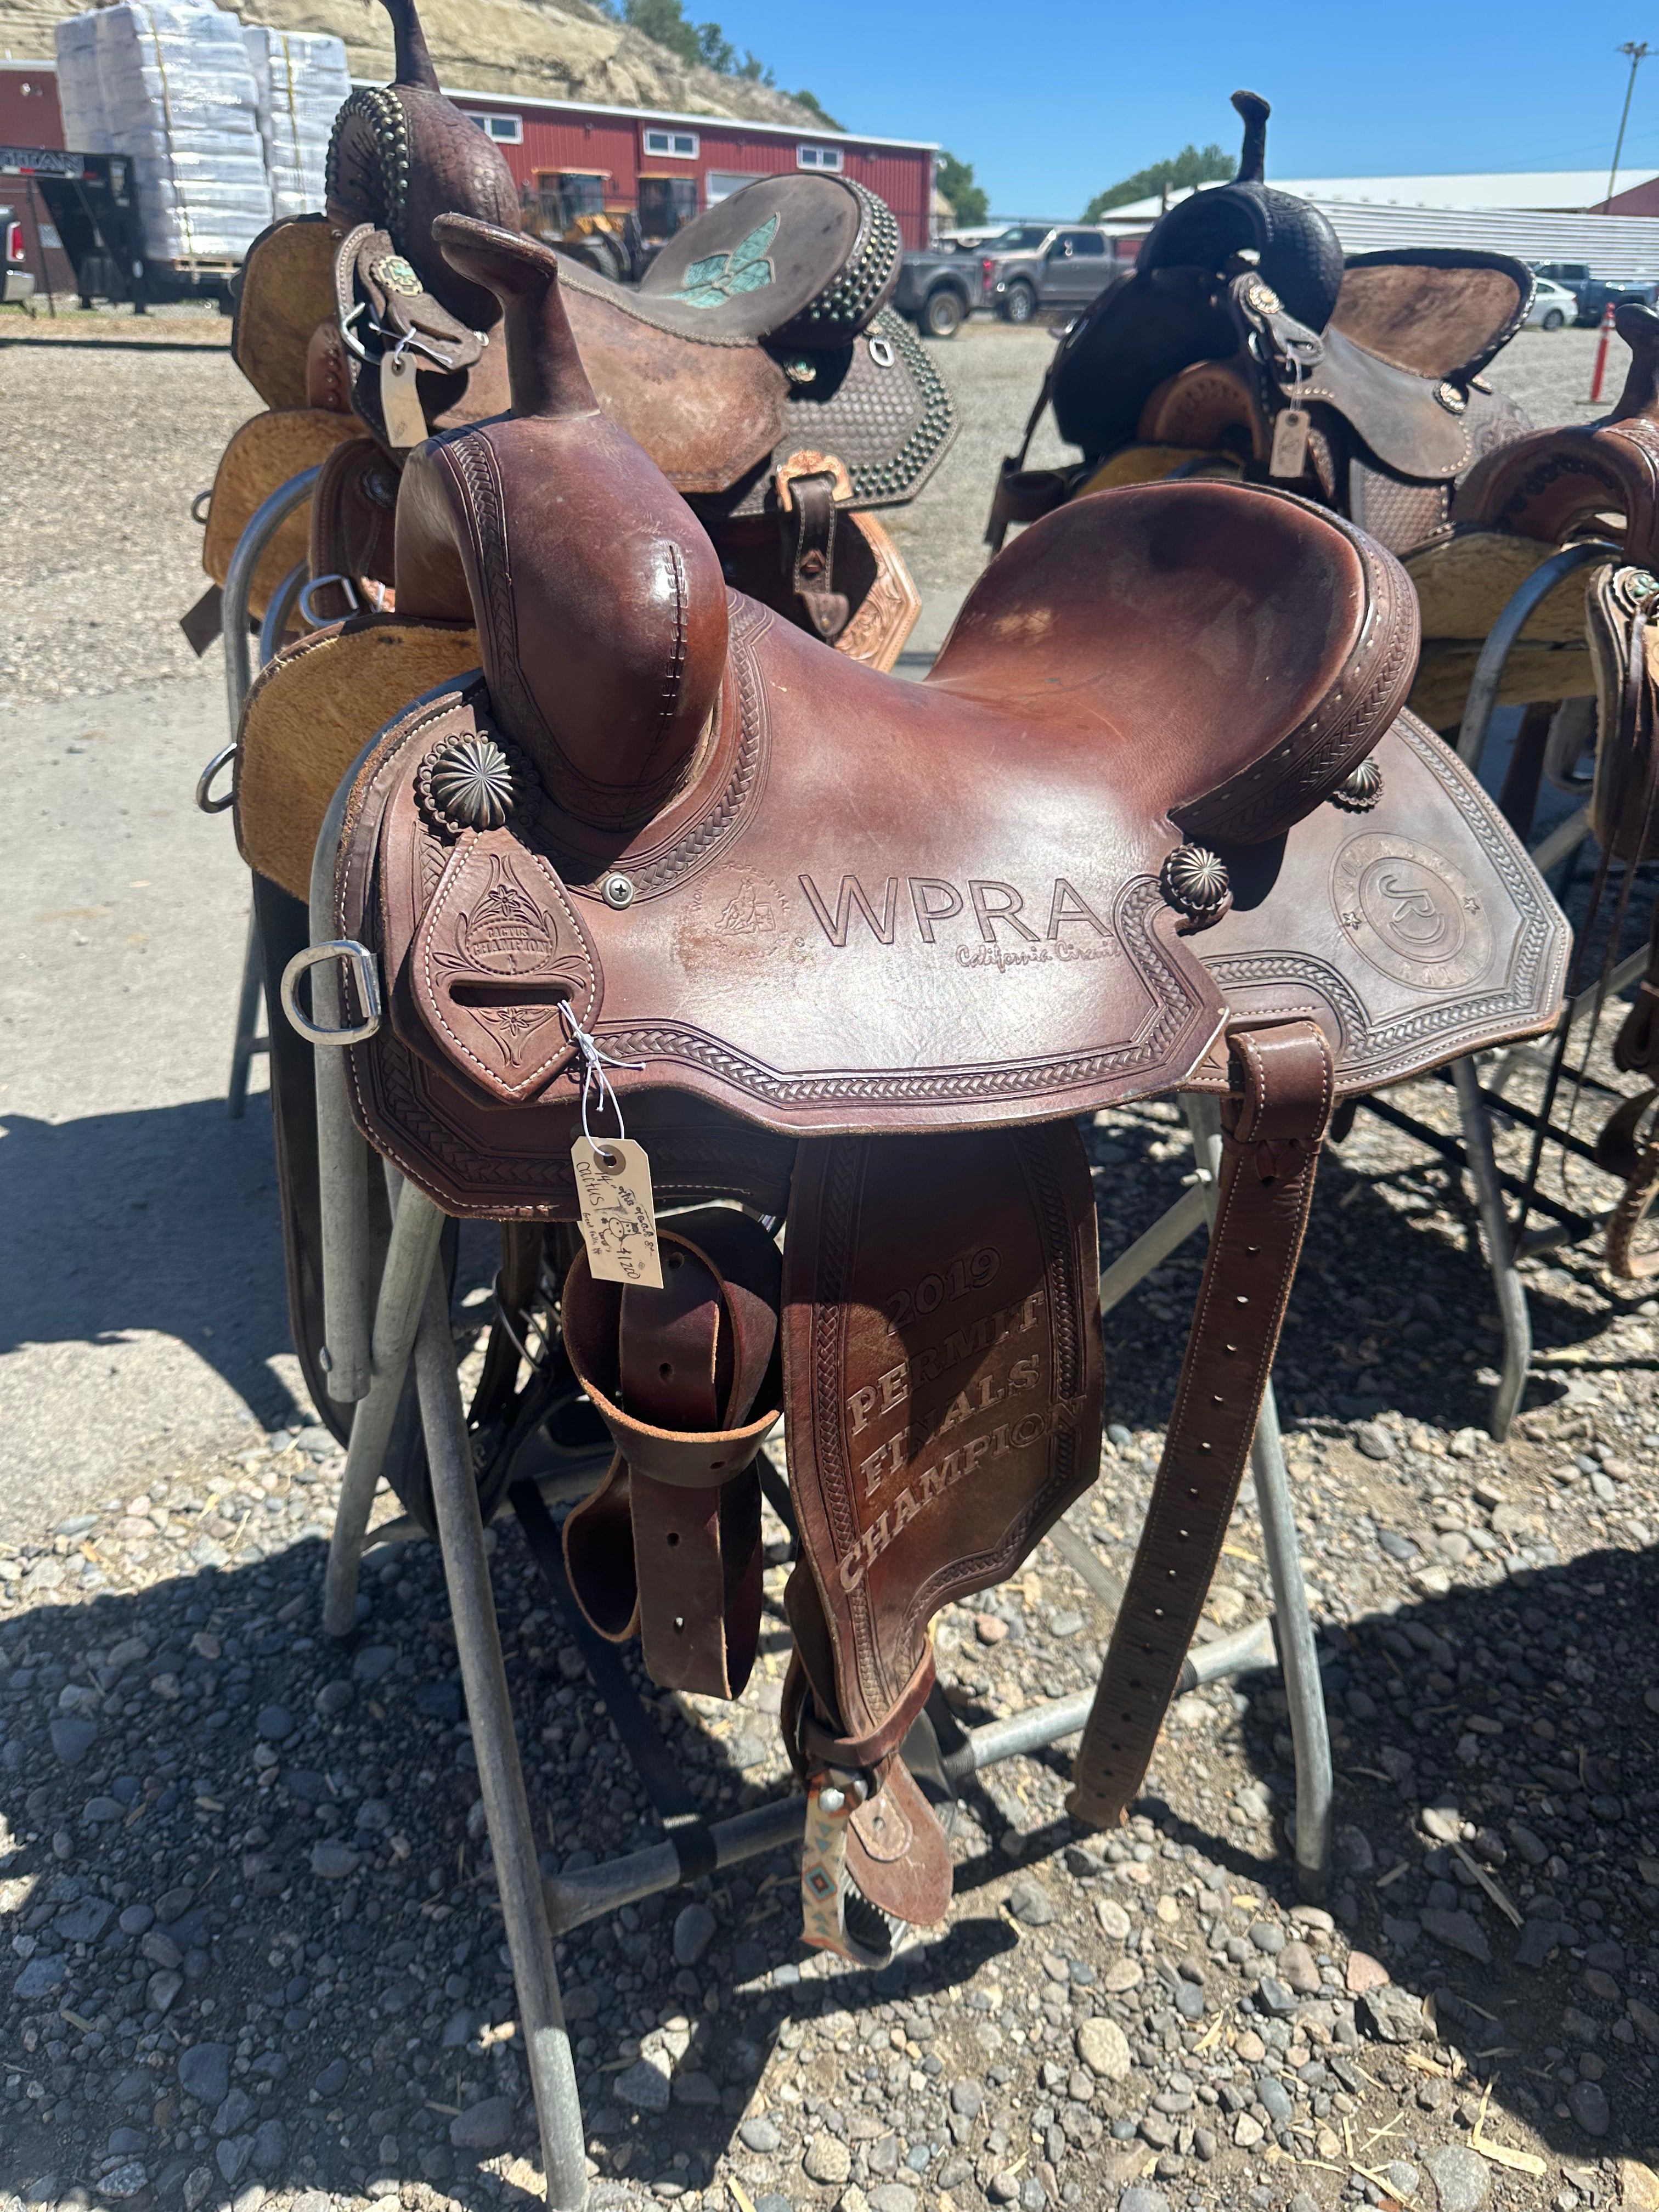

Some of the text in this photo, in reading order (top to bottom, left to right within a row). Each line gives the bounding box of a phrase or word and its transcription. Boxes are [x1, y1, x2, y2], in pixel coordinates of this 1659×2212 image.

[487, 927, 529, 938] CACTUS
[798, 874, 1114, 947] WPRA
[956, 941, 1053, 974] California
[884, 1246, 1002, 1337] 2019
[847, 1290, 1045, 1436] PERMIT
[860, 1353, 1040, 1498] FINALS
[839, 1393, 1087, 1592] CHAMPION
